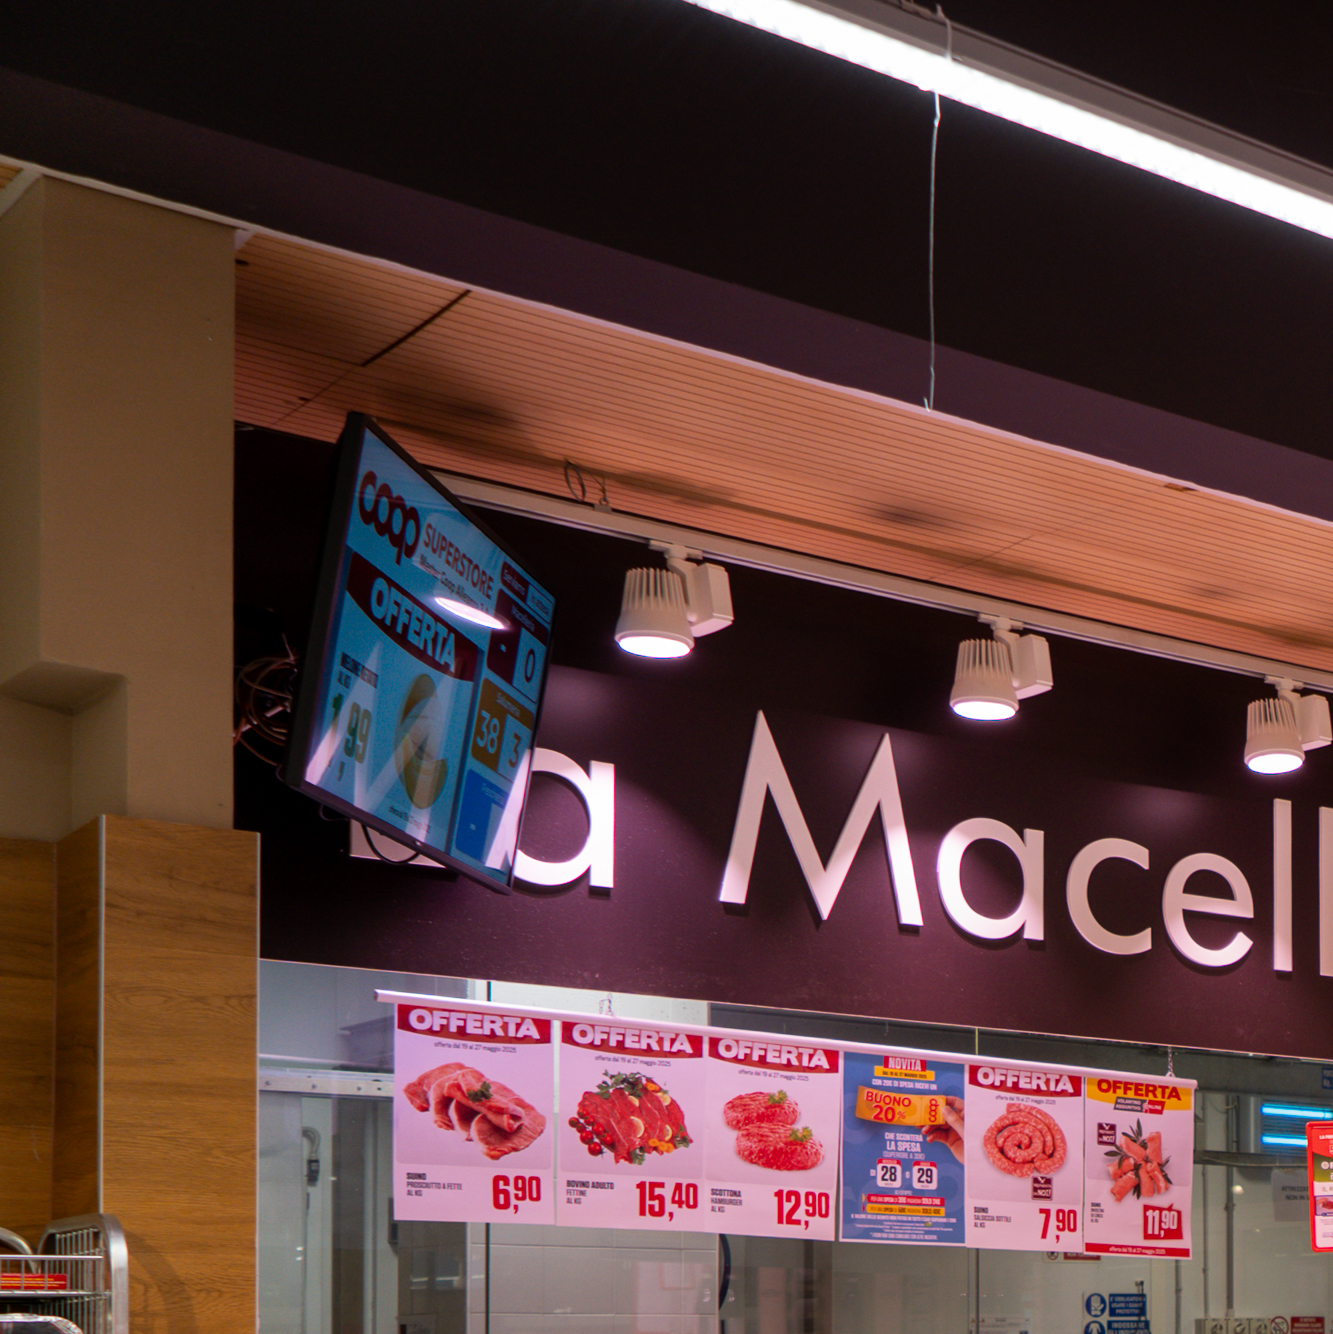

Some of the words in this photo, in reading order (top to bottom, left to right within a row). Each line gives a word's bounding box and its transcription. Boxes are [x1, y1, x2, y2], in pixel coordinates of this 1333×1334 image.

[358, 471, 420, 566] coop
[423, 523, 494, 600] SUPERSTORE
[371, 577, 455, 673] OFFERTA
[476, 710, 499, 754] 38
[508, 732, 521, 768] 3
[409, 1009, 540, 1039] OFFERTA
[461, 1042, 467, 1050] 19
[482, 1045, 501, 1054] maggio
[572, 1024, 693, 1054] OFFERTA
[718, 1039, 830, 1069] OFFERTA
[977, 1067, 1073, 1093] OFFERTA
[1097, 1079, 1181, 1100] OFFERTA
[865, 1091, 911, 1107] BUONO
[929, 1099, 939, 1123] coop
[885, 1132, 895, 1140] CHE
[887, 1141, 896, 1151] LA
[898, 1142, 921, 1152] SPESA
[406, 1181, 442, 1190] PROSCIUTTO
[447, 1182, 462, 1190] FETTE
[566, 1180, 589, 1189] BOVINO
[591, 1182, 614, 1190] ADULTO
[881, 1166, 897, 1182] 28
[918, 1168, 933, 1184] 29
[493, 1175, 541, 1214] 6,90
[566, 1188, 587, 1196] FETTINE
[636, 1181, 698, 1221] 15,40
[711, 1188, 742, 1197] SCOTTONA
[711, 1198, 742, 1206] HAMBURGER
[774, 1189, 830, 1230] 12,90
[1039, 1208, 1077, 1243] 7,90
[1146, 1209, 1178, 1238] 11,90
